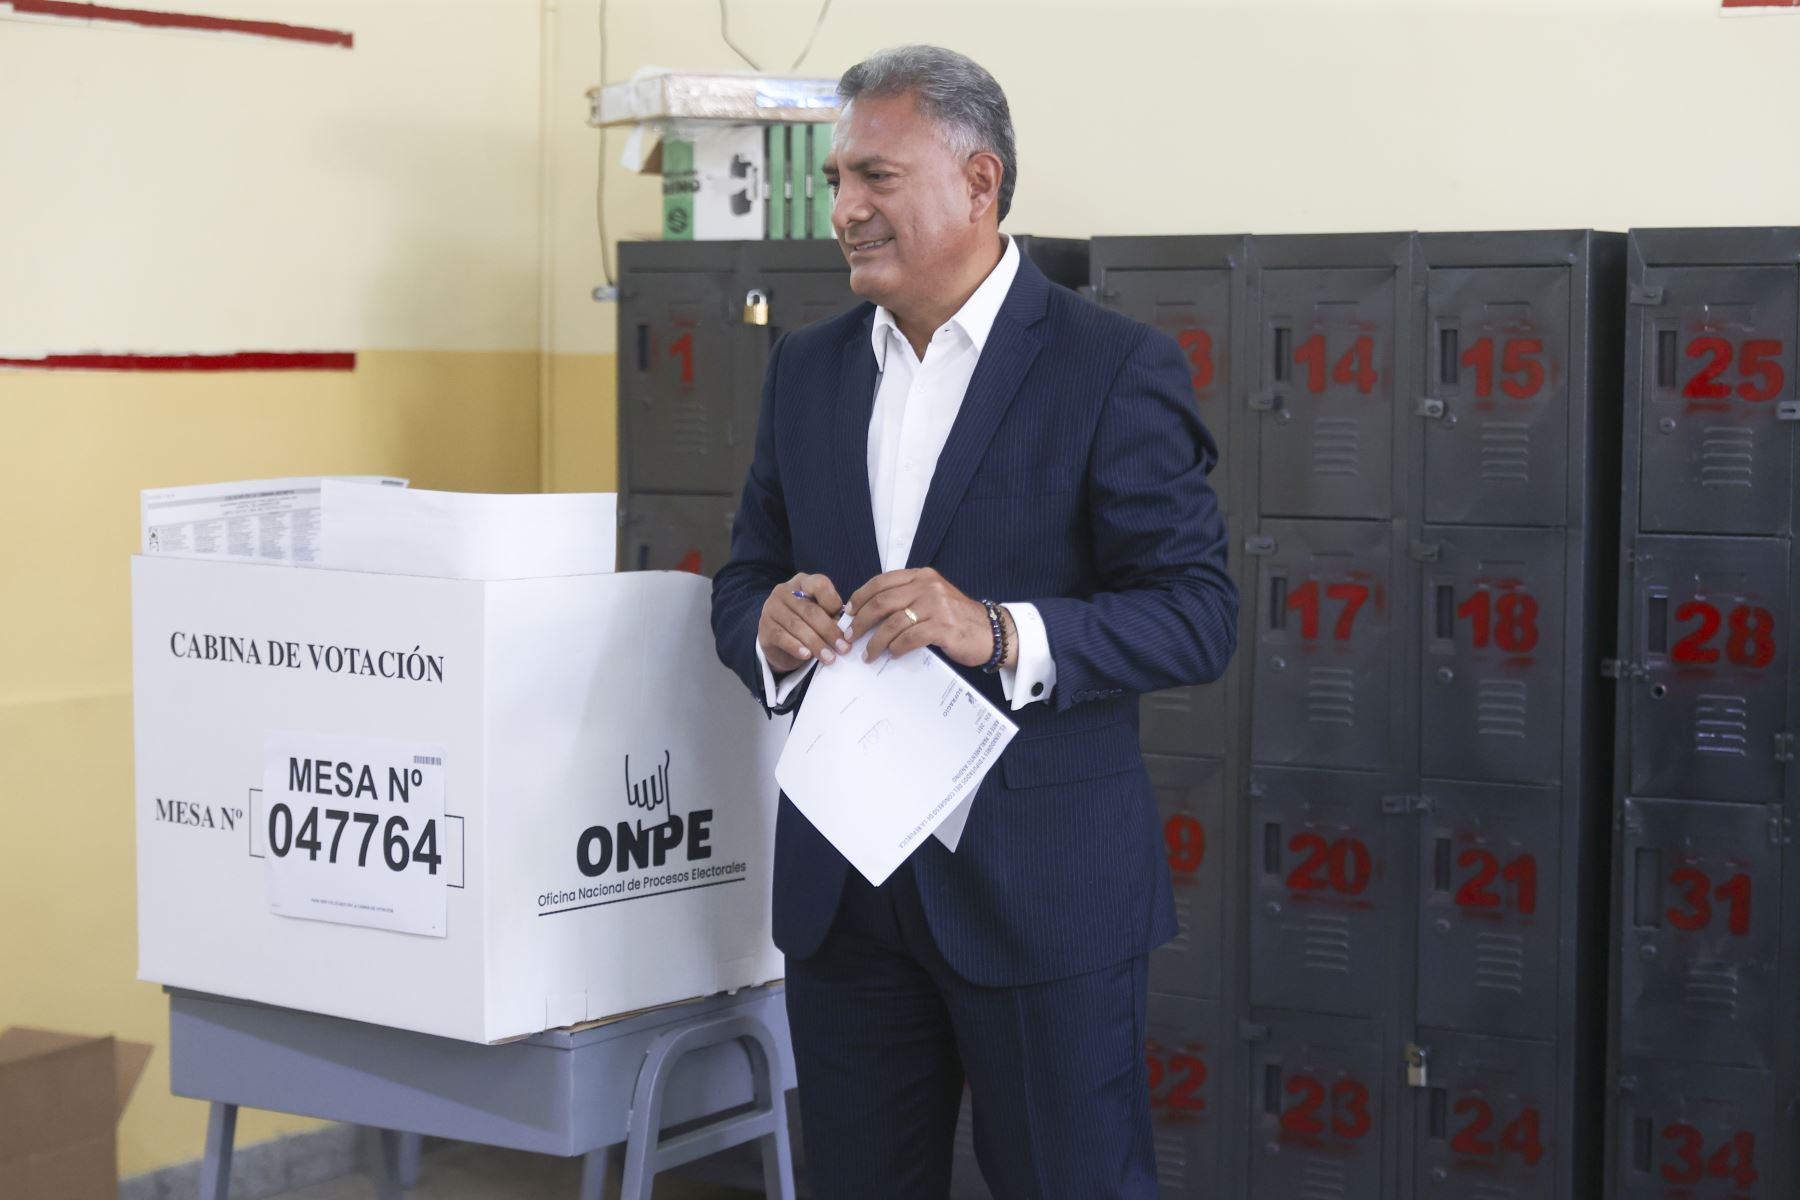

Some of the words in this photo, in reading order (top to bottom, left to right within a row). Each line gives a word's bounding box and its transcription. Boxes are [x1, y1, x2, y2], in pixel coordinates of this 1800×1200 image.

[670, 333, 694, 384] 1
[1182, 330, 1214, 389] 3
[1294, 335, 1377, 394] 14
[1461, 337, 1545, 399] 15
[1683, 336, 1784, 402] 25
[1288, 581, 1370, 641] 17
[1457, 590, 1538, 653] 18
[1671, 602, 1775, 668] 28
[170, 631, 262, 666] CABINA
[267, 641, 301, 669] DE
[307, 643, 446, 683] VOTACIÓN
[288, 757, 379, 801] MESA
[388, 766, 423, 804] Nº
[155, 798, 216, 830] MESA
[268, 802, 442, 876] 047764
[577, 808, 713, 877] ONPE
[1164, 814, 1204, 873] 9
[537, 889, 576, 907] Oficina
[578, 879, 625, 901] Nacional
[627, 880, 641, 891] de
[643, 871, 689, 889] Procesos
[691, 861, 747, 881] Electorales
[1286, 833, 1371, 895] 20
[1455, 849, 1537, 914] 21
[1667, 867, 1751, 935] 31
[1281, 1075, 1371, 1140] 23
[1450, 1098, 1543, 1166] 24
[1659, 1124, 1759, 1190] 34
